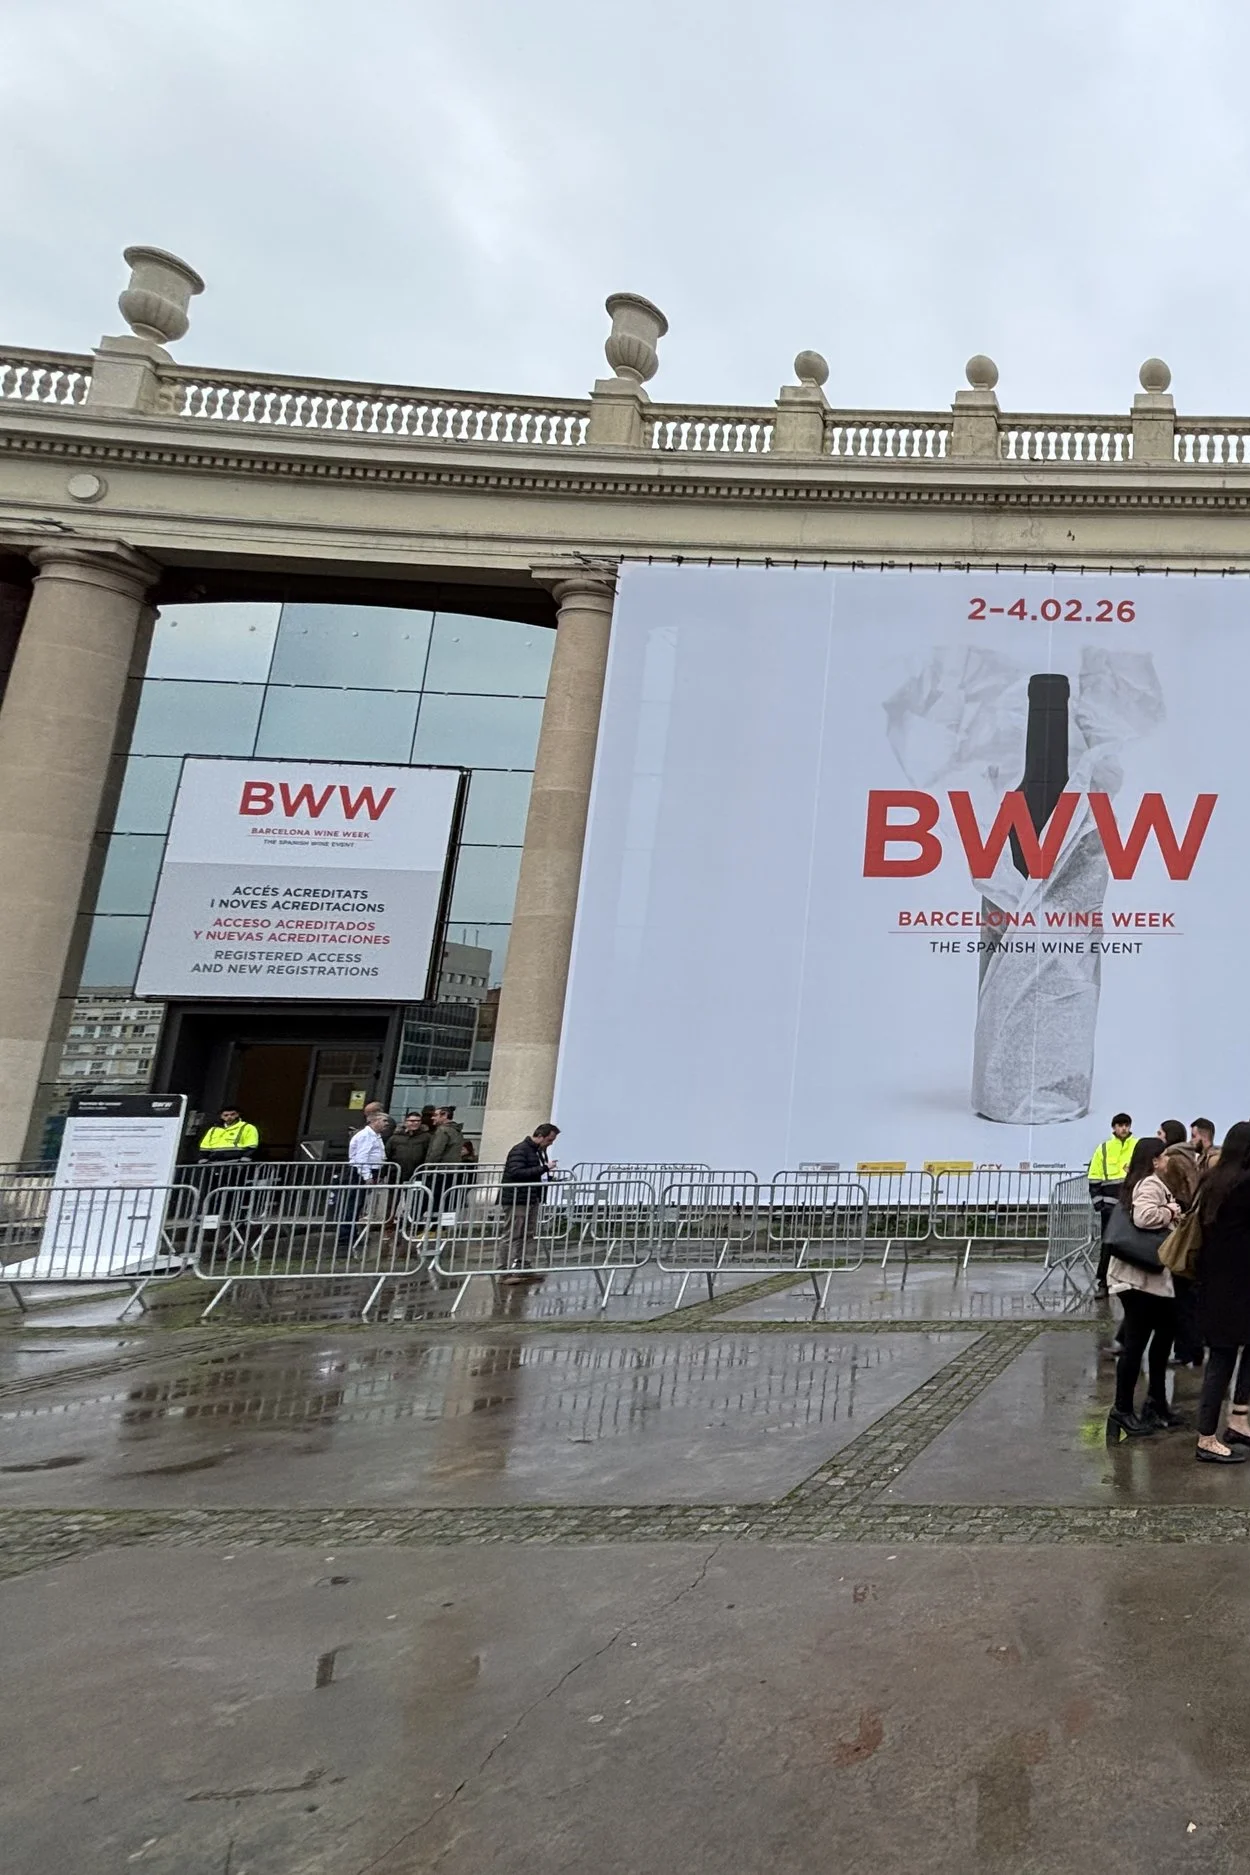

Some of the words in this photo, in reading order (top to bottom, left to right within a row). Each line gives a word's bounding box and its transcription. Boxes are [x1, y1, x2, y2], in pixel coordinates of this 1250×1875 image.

[239, 781, 396, 821] BWW
[251, 828, 310, 836] BARCELONA
[863, 790, 1218, 881] BWW
[232, 885, 279, 897] ACCÉS
[282, 888, 368, 899] ACREDITATS
[210, 899, 215, 908] I
[218, 899, 268, 909] NOVES
[271, 900, 385, 913] ACREDITACIONS
[213, 918, 271, 928] ACCESO
[275, 920, 375, 931] ACREDITADOS
[899, 911, 1036, 927] BARCELONA
[1045, 912, 1103, 927] WINE
[1112, 913, 1174, 927] WEEK
[194, 931, 203, 940] Y
[206, 931, 263, 941] NUEVAS
[267, 933, 390, 945] ACREDITACIONES
[930, 941, 961, 954] THE
[966, 941, 1036, 954] SPANISH
[1042, 942, 1085, 954] WINE
[1090, 942, 1143, 954] EVENT
[214, 950, 303, 961] REGISTERED
[306, 952, 362, 963] ACCESS
[191, 963, 223, 973] AND
[227, 964, 263, 974] NEW
[266, 965, 379, 976] REGISTRATIONS
